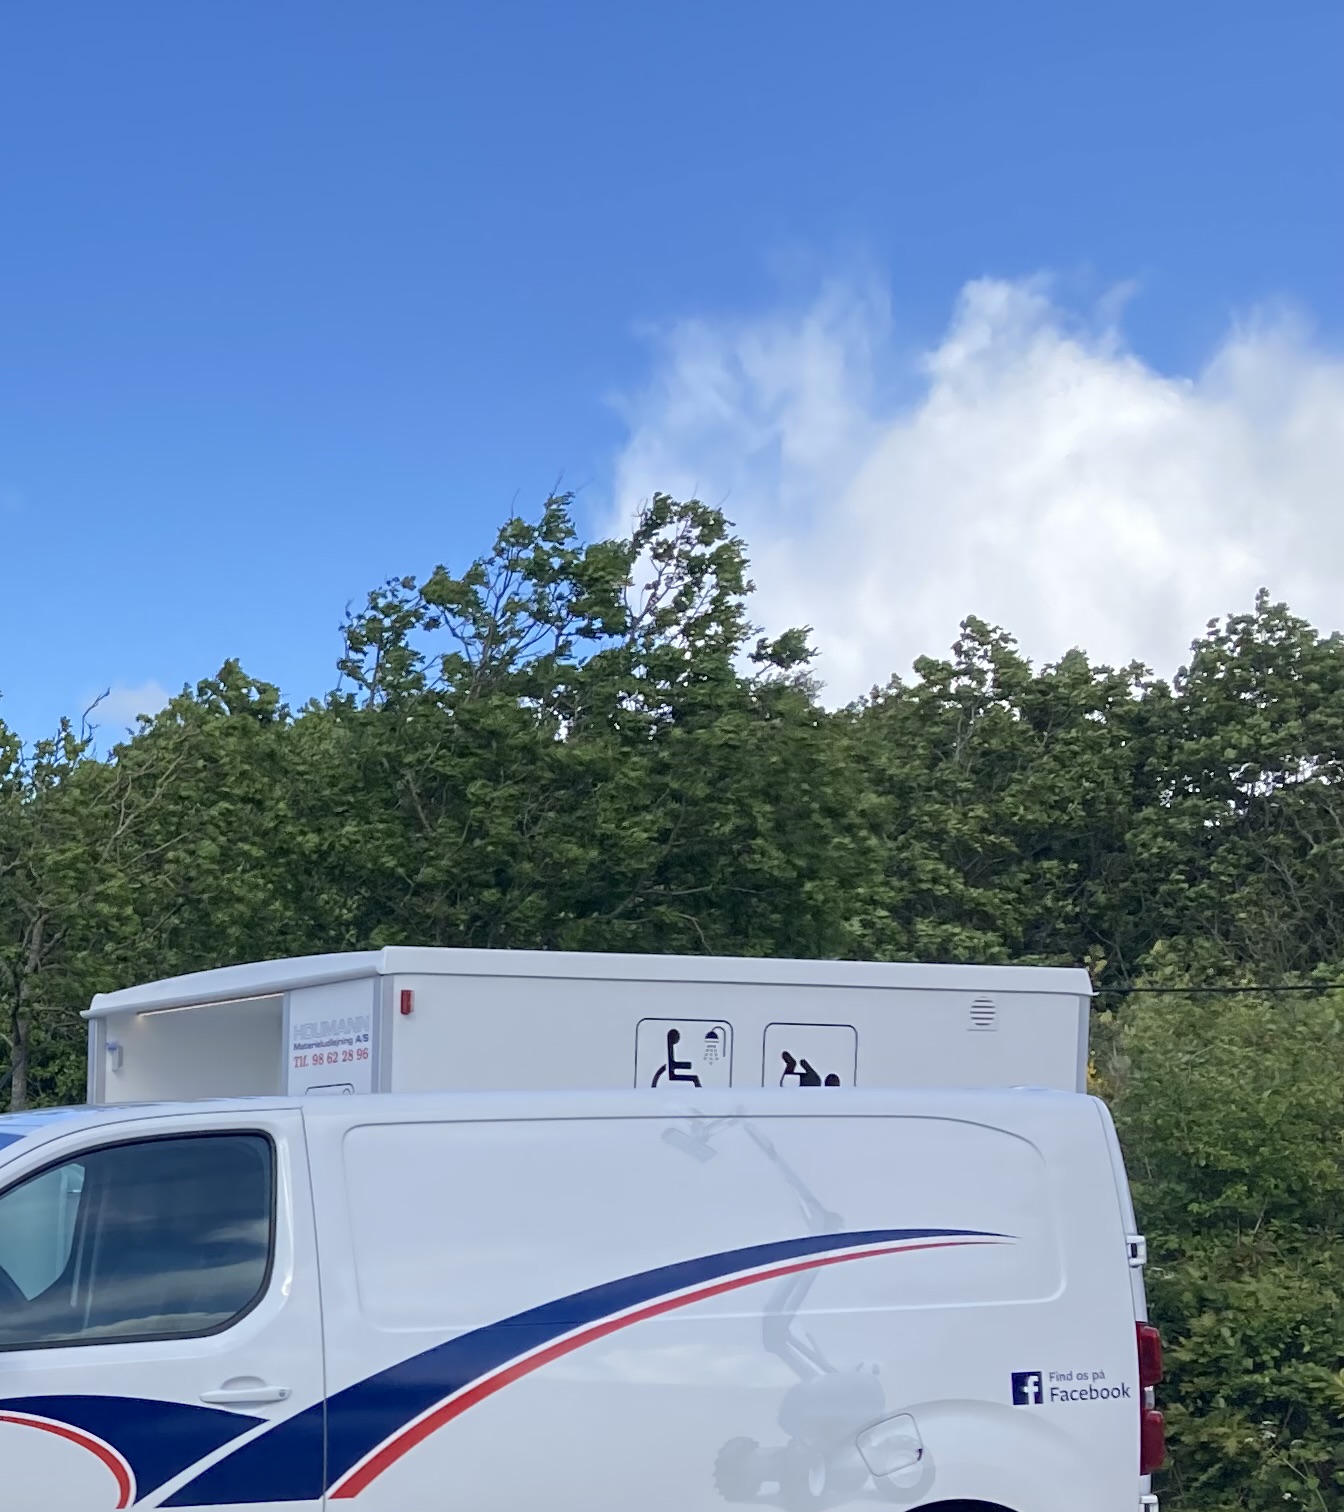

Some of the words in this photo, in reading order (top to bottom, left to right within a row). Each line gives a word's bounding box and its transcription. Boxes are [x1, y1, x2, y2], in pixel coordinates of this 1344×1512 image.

[355, 1033, 369, 1043] AS
[312, 1053, 325, 1066] 98
[327, 1051, 339, 1064] 62
[342, 1049, 354, 1062] 28
[356, 1047, 370, 1060] 96
[1048, 1371, 1073, 1382] Find
[1076, 1372, 1089, 1381] os
[1050, 1382, 1131, 1402] Facebook
